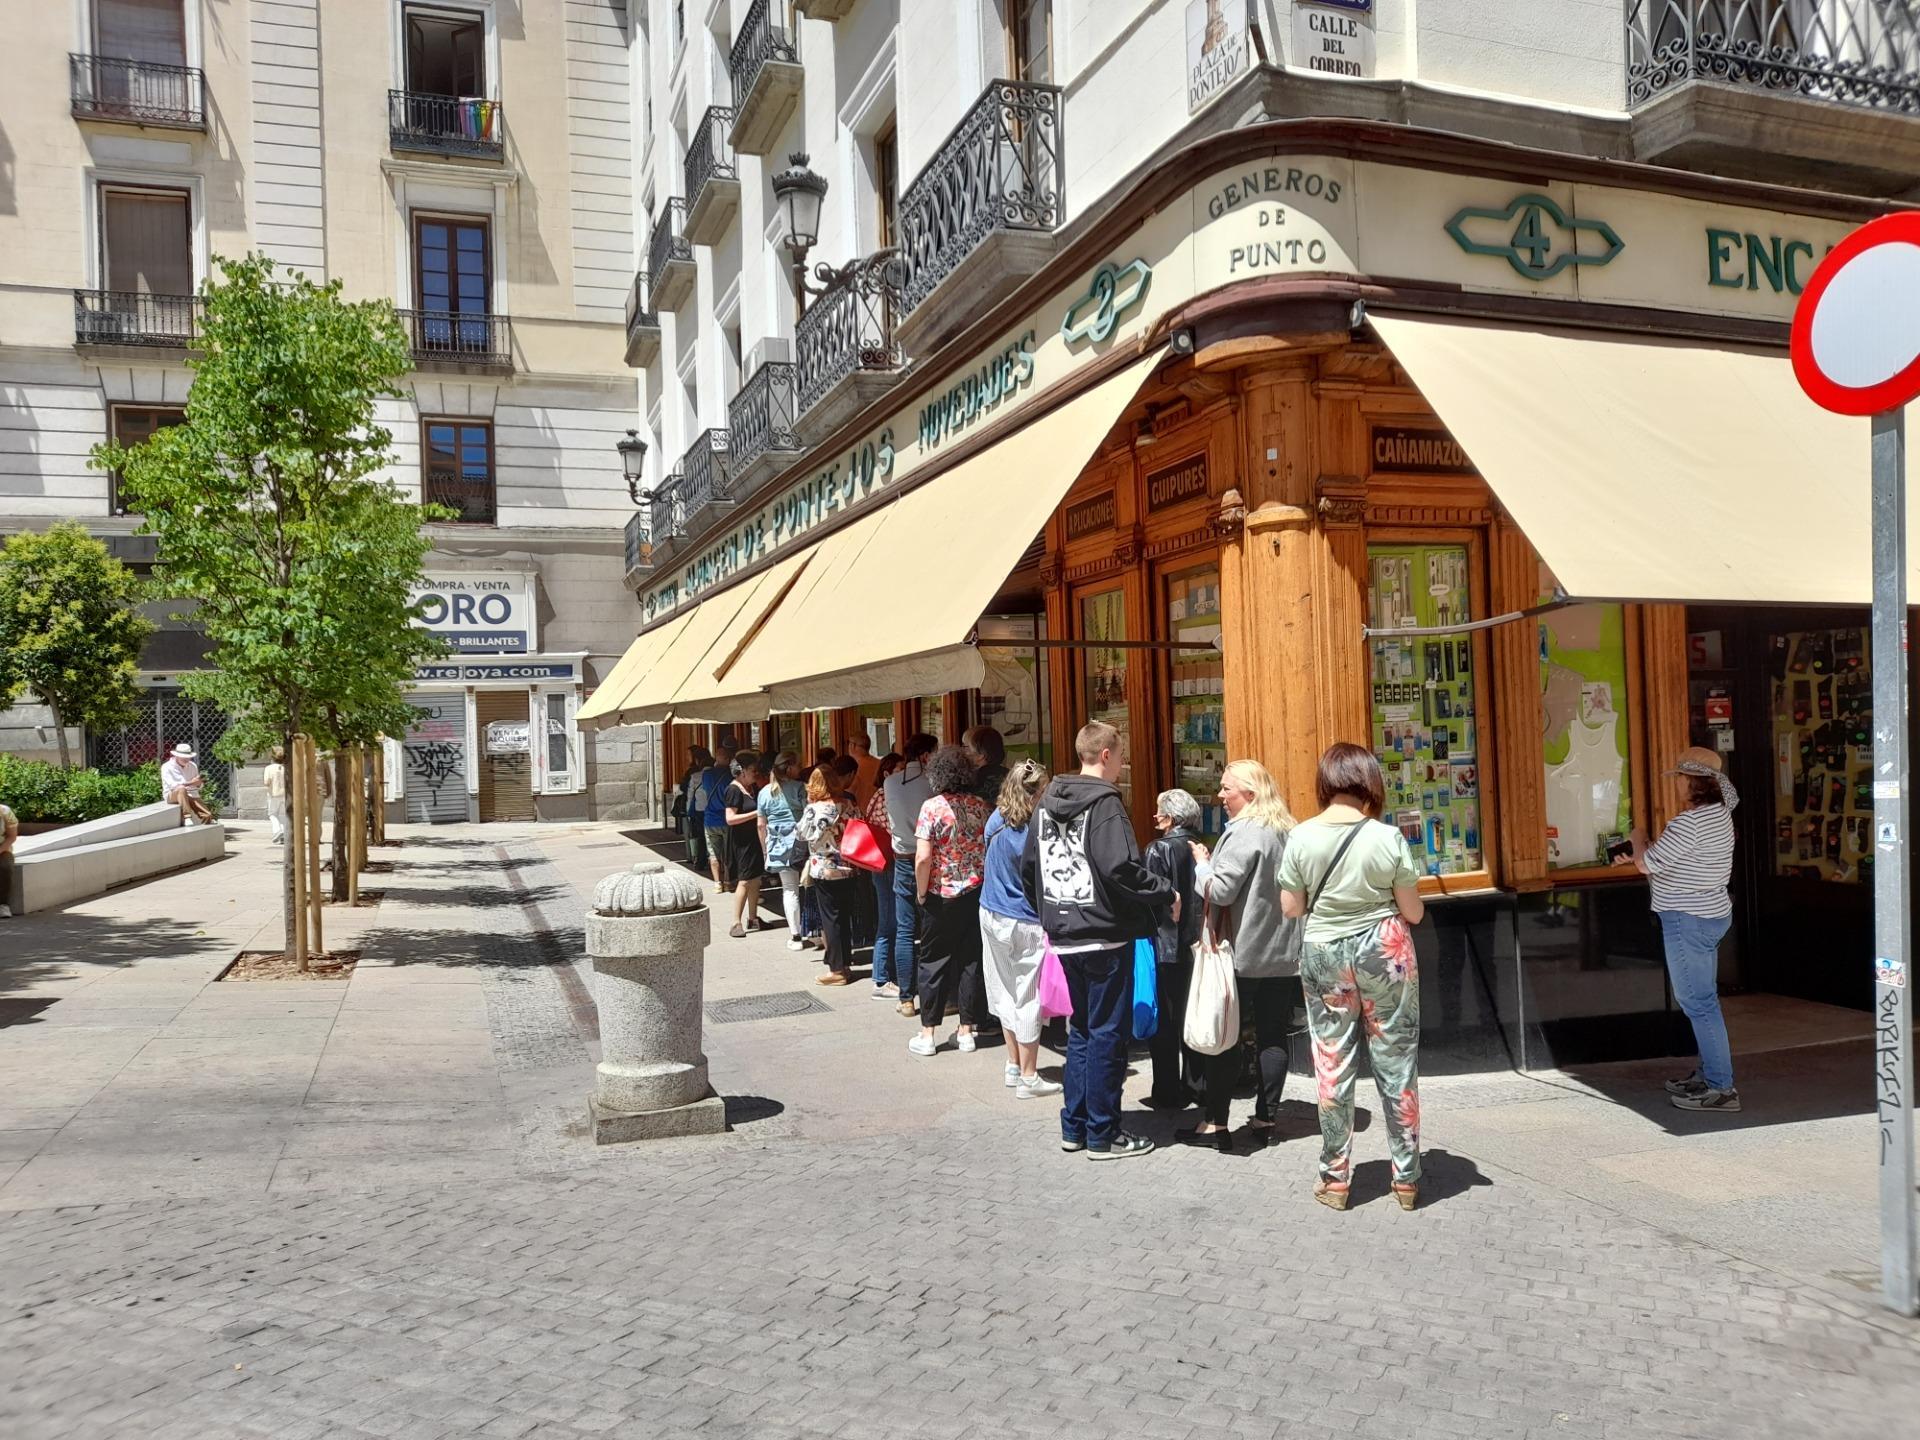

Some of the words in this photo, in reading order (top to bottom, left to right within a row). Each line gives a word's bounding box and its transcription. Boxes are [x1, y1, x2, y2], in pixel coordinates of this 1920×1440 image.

[1309, 13, 1358, 38] CALLE
[1322, 37, 1345, 54] DEL
[1208, 167, 1342, 220] GENEROS
[1259, 208, 1286, 228] DE
[1510, 205, 1551, 268] 4
[1229, 238, 1327, 274] PUNTO
[1705, 228, 1836, 297] ENC
[918, 329, 1036, 452] NOVEDADES
[1375, 432, 1472, 468] CAÑAMAZO
[743, 512, 766, 559] DE
[772, 427, 896, 543] PONTEJOS
[1151, 463, 1206, 505] GUIPURES
[1068, 498, 1114, 534] APLICACIONES
[414, 581, 466, 591] COMPRA
[473, 581, 511, 591] VENTA
[415, 593, 512, 625] ORO
[458, 637, 520, 647] BRILLANTES
[413, 666, 551, 680] w.rejoya.com
